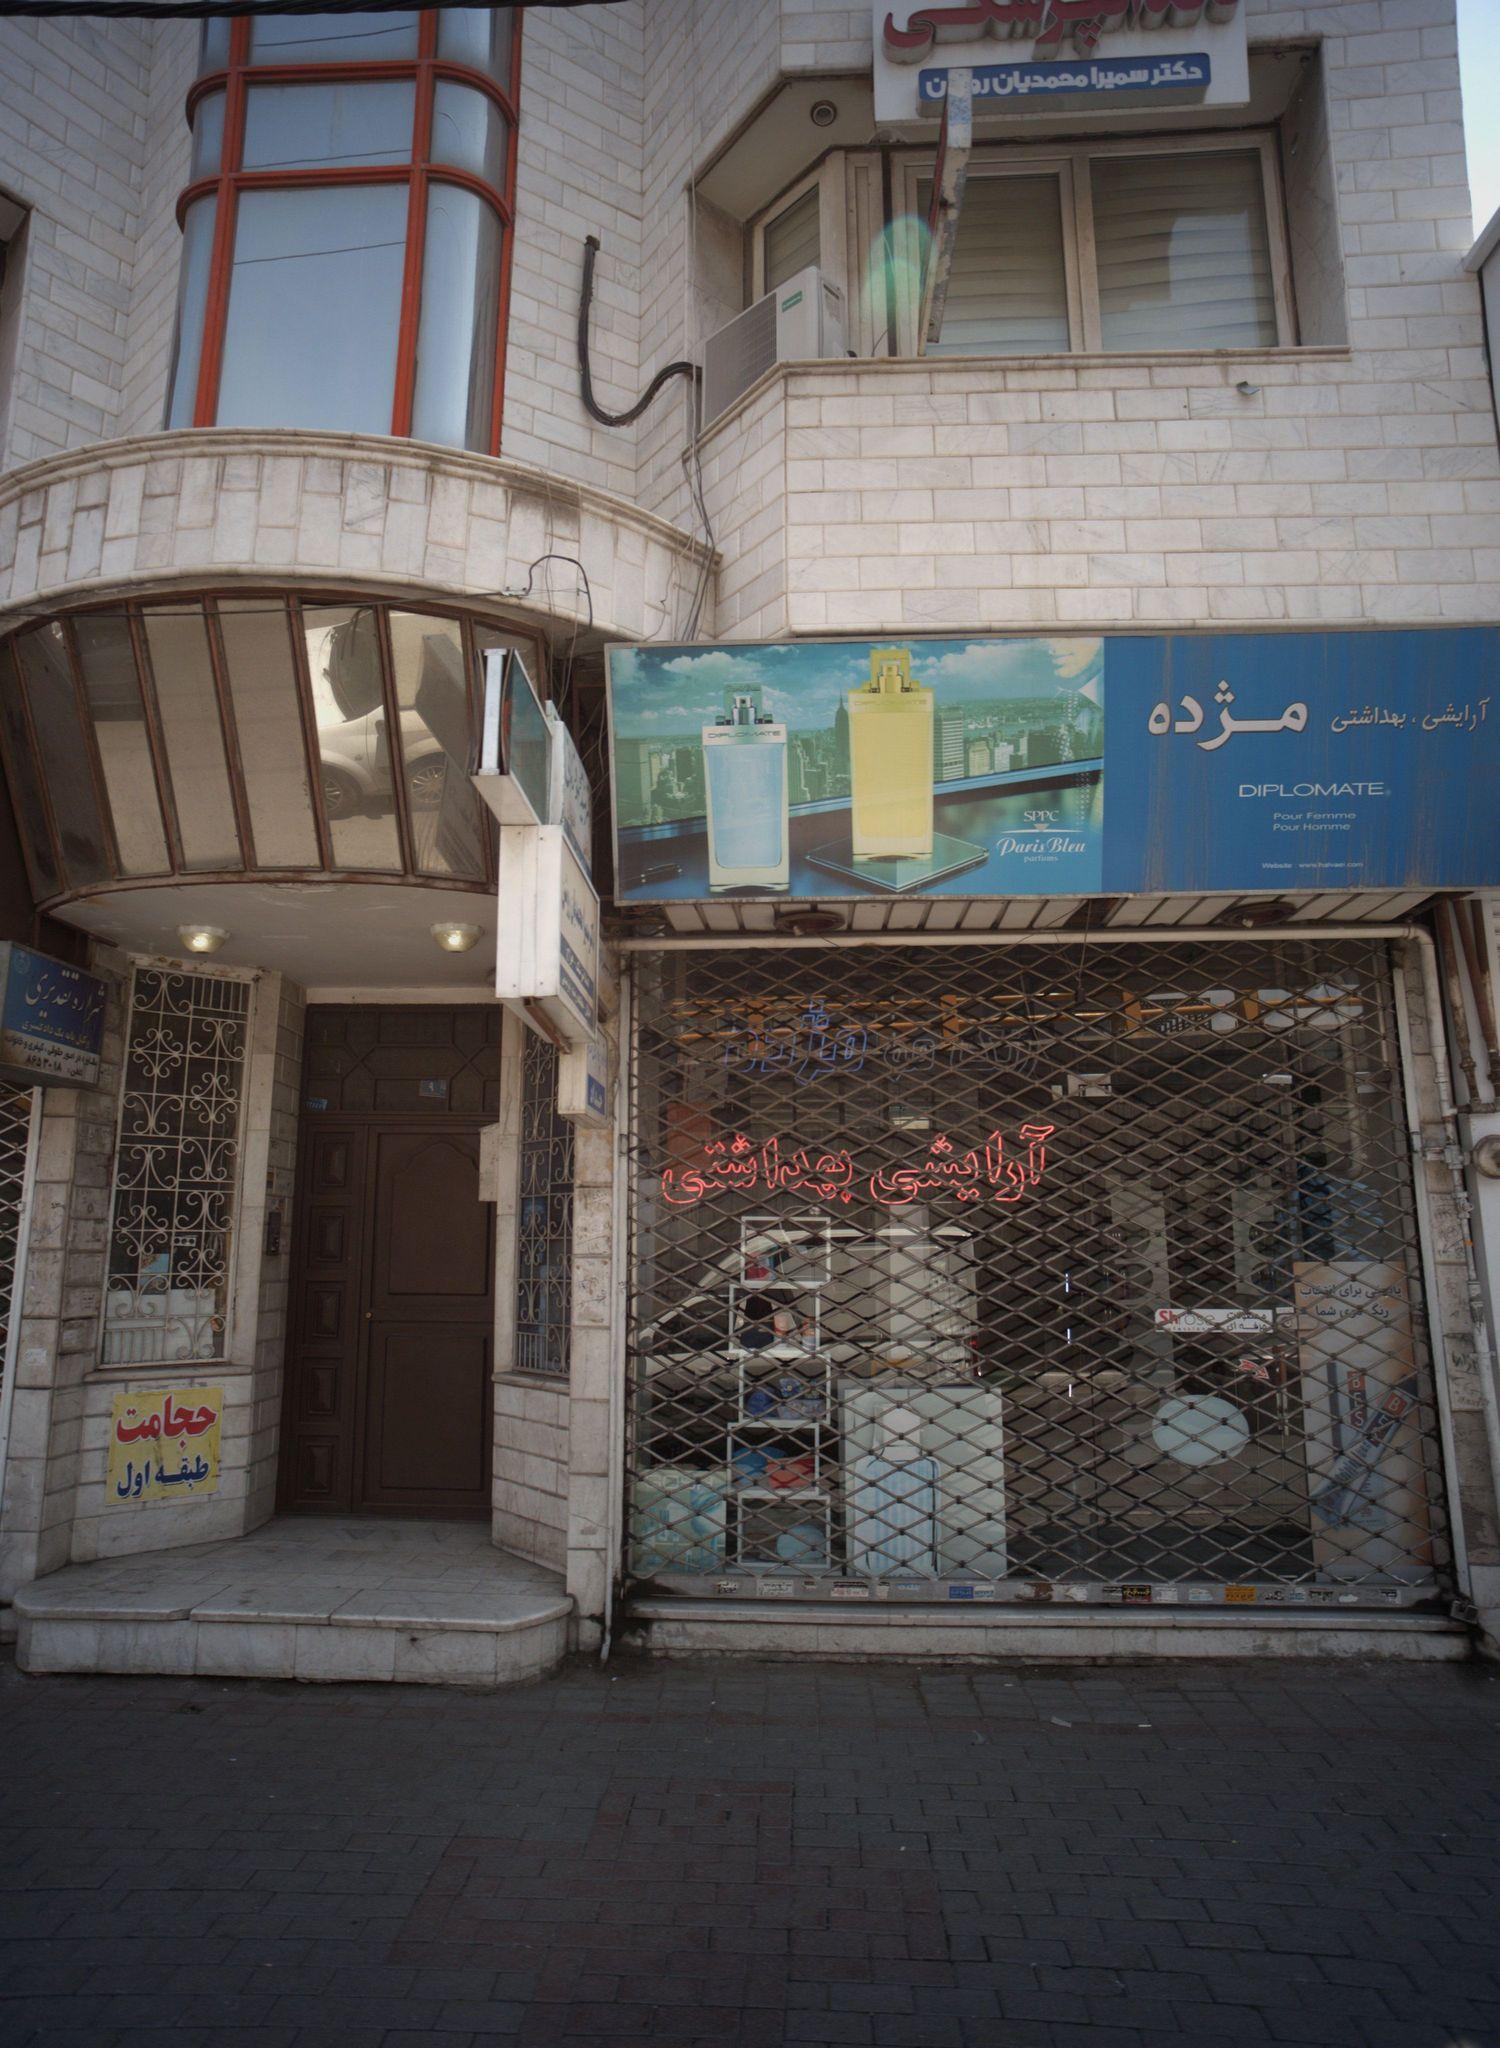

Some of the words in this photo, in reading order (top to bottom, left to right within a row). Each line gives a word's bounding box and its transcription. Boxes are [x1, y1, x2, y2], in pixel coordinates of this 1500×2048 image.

[993, 70, 1086, 97] محمدیان
[1091, 66, 1149, 89] سمیرا
[1150, 60, 1203, 87] دکتر
[1148, 679, 1308, 751] مژده
[1331, 704, 1407, 733] بهداشتی
[1421, 697, 1491, 732] آرایشی
[1238, 782, 1385, 798] DIPLOMATE
[1023, 809, 1060, 823] SPPC
[1272, 823, 1301, 832] Pour
[1303, 822, 1351, 831] Homme
[1273, 812, 1303, 821] Pour
[1306, 811, 1357, 821] Femme
[996, 836, 1044, 857] Paris
[1046, 836, 1087, 854] Bleu
[1023, 854, 1059, 864] parfums
[661, 1133, 853, 1205] بهداشتی
[870, 1124, 1055, 1205] آرایشی
[1315, 1304, 1337, 1316] شما
[116, 1395, 217, 1449] حجامت
[117, 1460, 150, 1497] اول
[155, 1454, 210, 1490] طبقه
